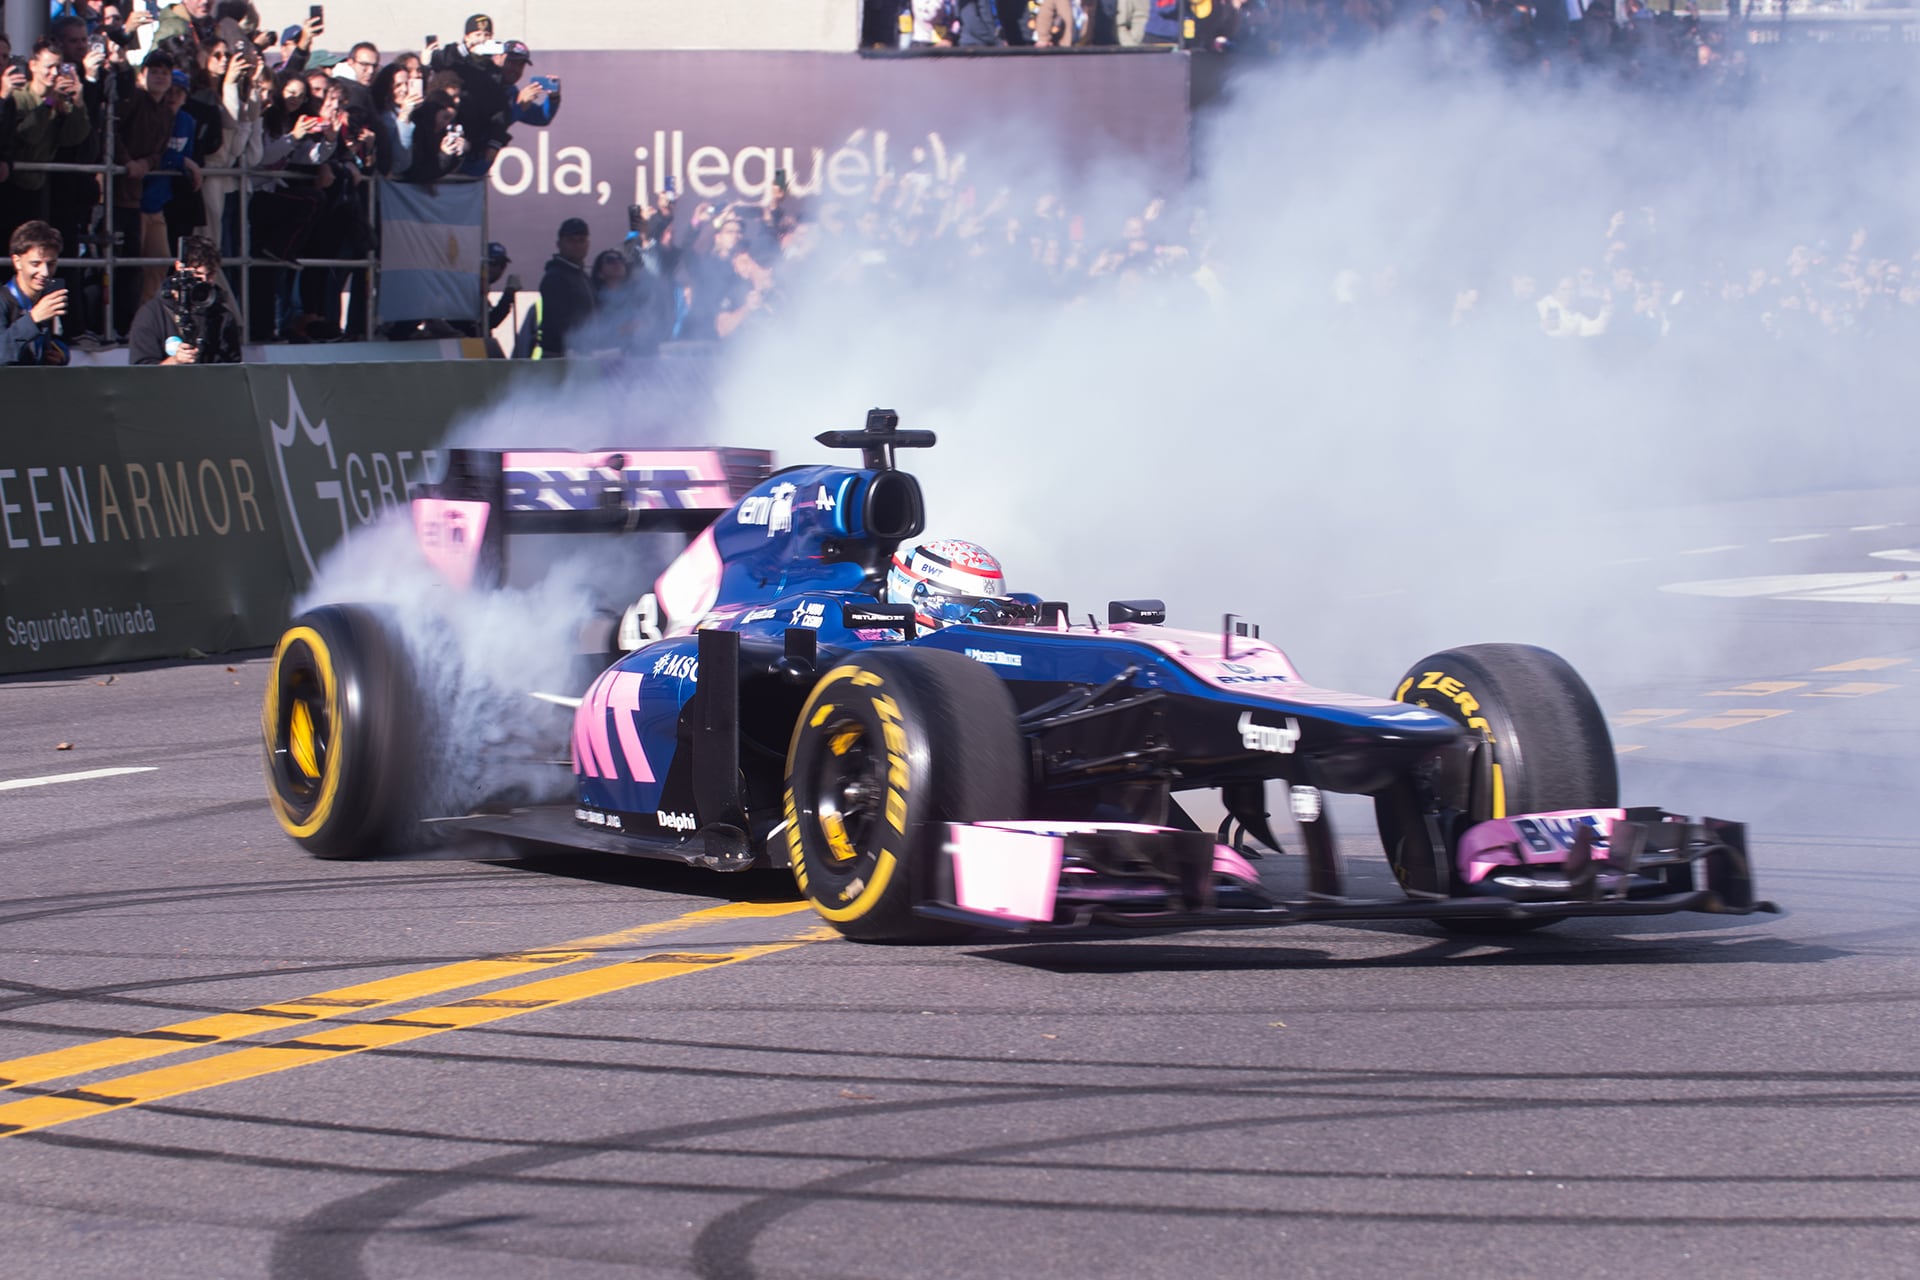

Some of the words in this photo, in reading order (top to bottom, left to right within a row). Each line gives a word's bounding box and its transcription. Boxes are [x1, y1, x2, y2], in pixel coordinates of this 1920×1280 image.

[0, 458, 265, 549] EENARMOR
[5, 608, 91, 651] Seguridad
[92, 603, 156, 637] Privada
[657, 809, 697, 832] Delphi
